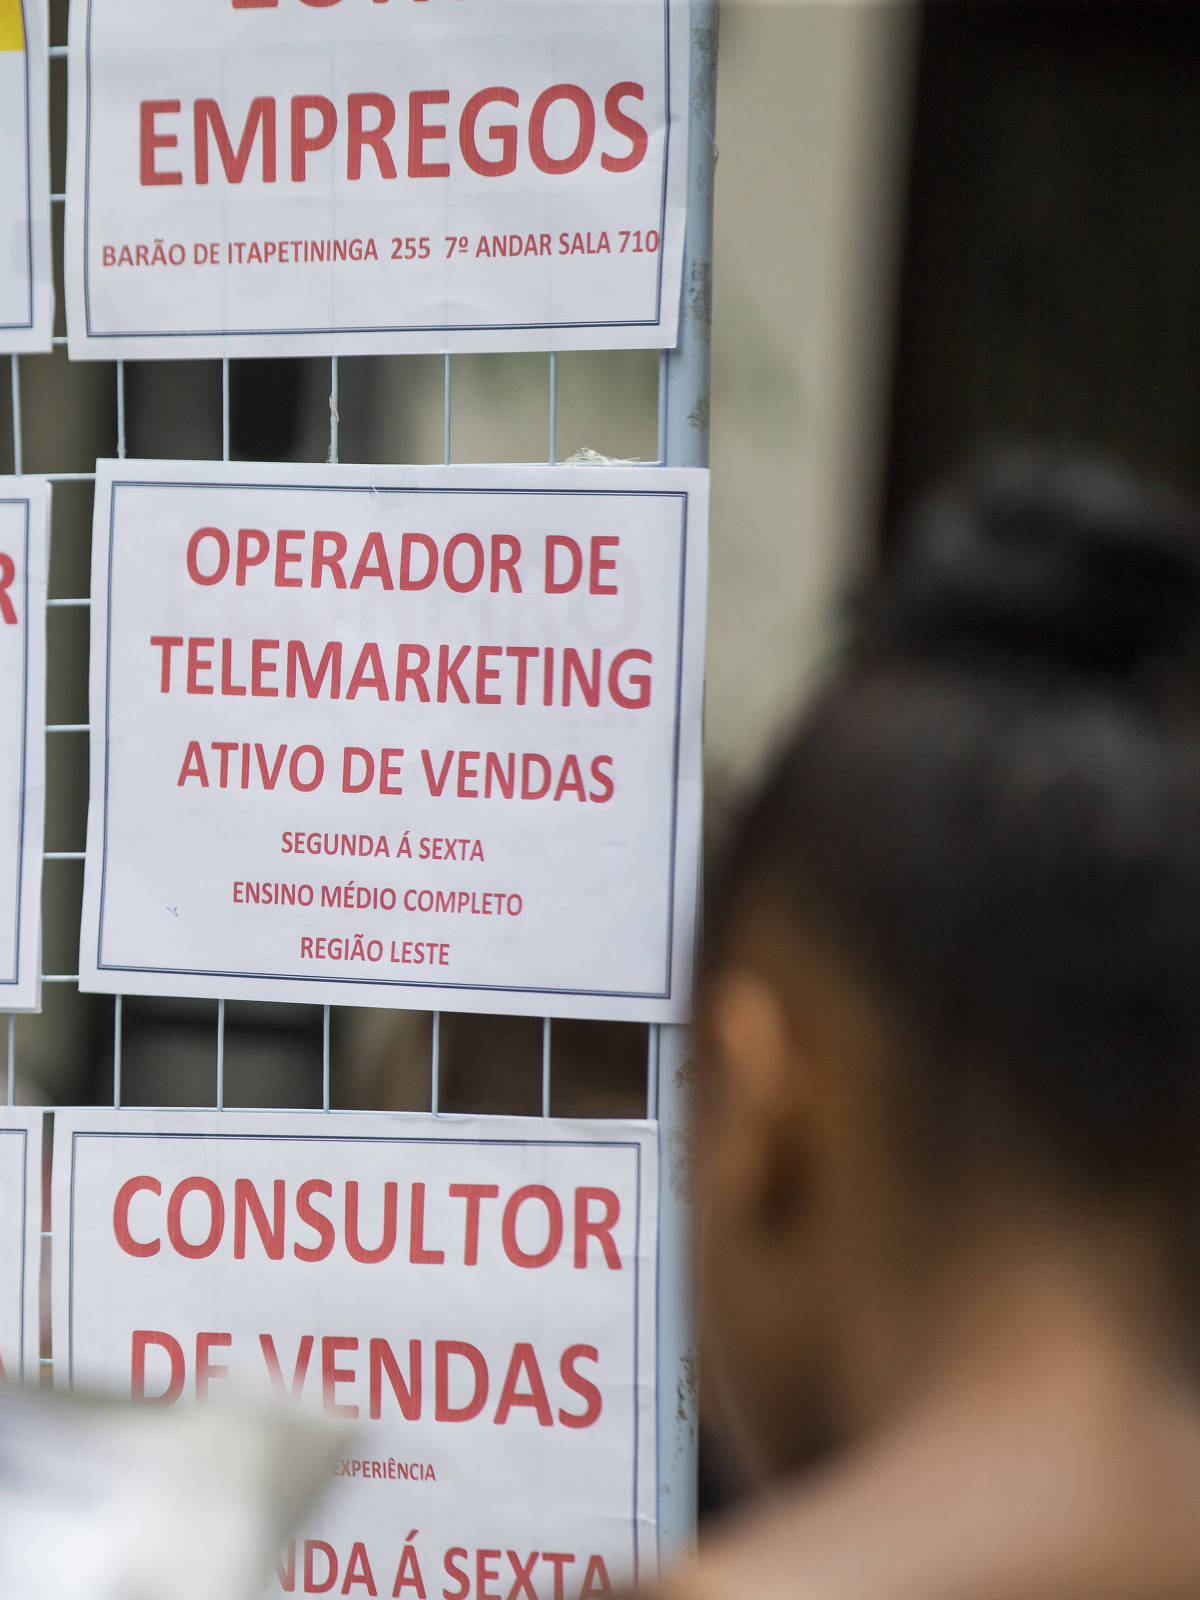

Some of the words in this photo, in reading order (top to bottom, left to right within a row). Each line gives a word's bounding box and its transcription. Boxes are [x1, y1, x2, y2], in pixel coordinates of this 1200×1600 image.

[139, 81, 649, 187] EMPREGOS
[102, 238, 187, 267] BARÃO
[193, 242, 220, 265] DE
[227, 238, 379, 265] ITAPETININGA
[391, 236, 431, 261] 255
[475, 233, 552, 258] ANDAR
[558, 231, 611, 256] SALA
[618, 229, 660, 254] 710
[186, 526, 523, 594] OPERADOR
[544, 534, 620, 596] DE
[149, 635, 653, 710] TELEMARKETING
[177, 740, 325, 793] ATIVO
[341, 746, 405, 796] DE
[420, 748, 615, 804] VENDAS
[281, 831, 390, 858] SEGUNDA
[396, 830, 413, 859] Á
[418, 837, 485, 862] SEXTA
[232, 881, 314, 907] ENSINO
[320, 880, 397, 911] MÉDIO
[403, 888, 523, 917] COMPLETO
[300, 933, 384, 963] REGIÃO
[390, 940, 450, 966] LESTE
[113, 1175, 623, 1271] CONSULTOR
[258, 1333, 603, 1430] VENDAS
[332, 1457, 437, 1481] EXPERIÊNCIA
[392, 1529, 426, 1599] Á
